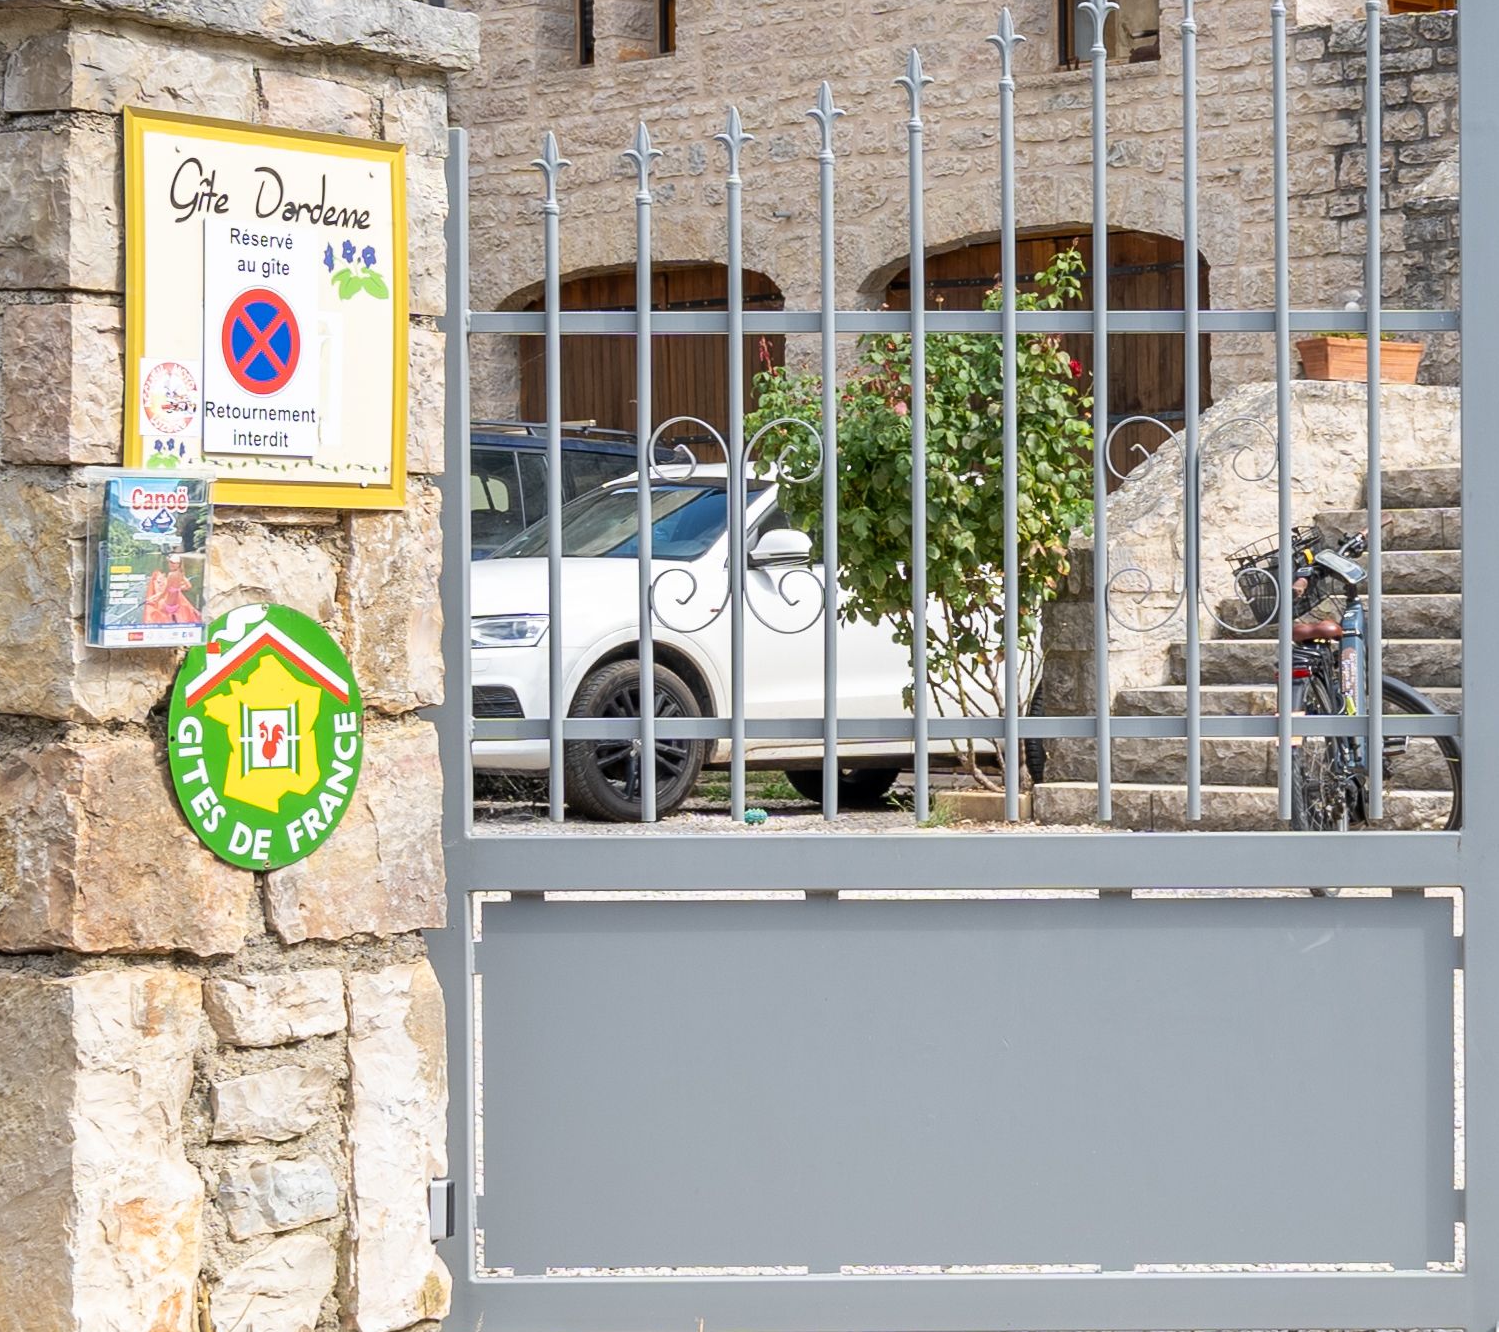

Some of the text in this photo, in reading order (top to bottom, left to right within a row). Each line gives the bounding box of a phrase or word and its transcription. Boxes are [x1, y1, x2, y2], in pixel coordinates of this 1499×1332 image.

[170, 157, 371, 230] Gîte Dardenne
[230, 227, 294, 250] Réservé
[237, 258, 290, 279] au gîte
[204, 400, 316, 423] Retournement
[233, 428, 289, 448] interdit
[131, 487, 188, 511] Canoë
[177, 711, 358, 860] GITES DE FRANCE
